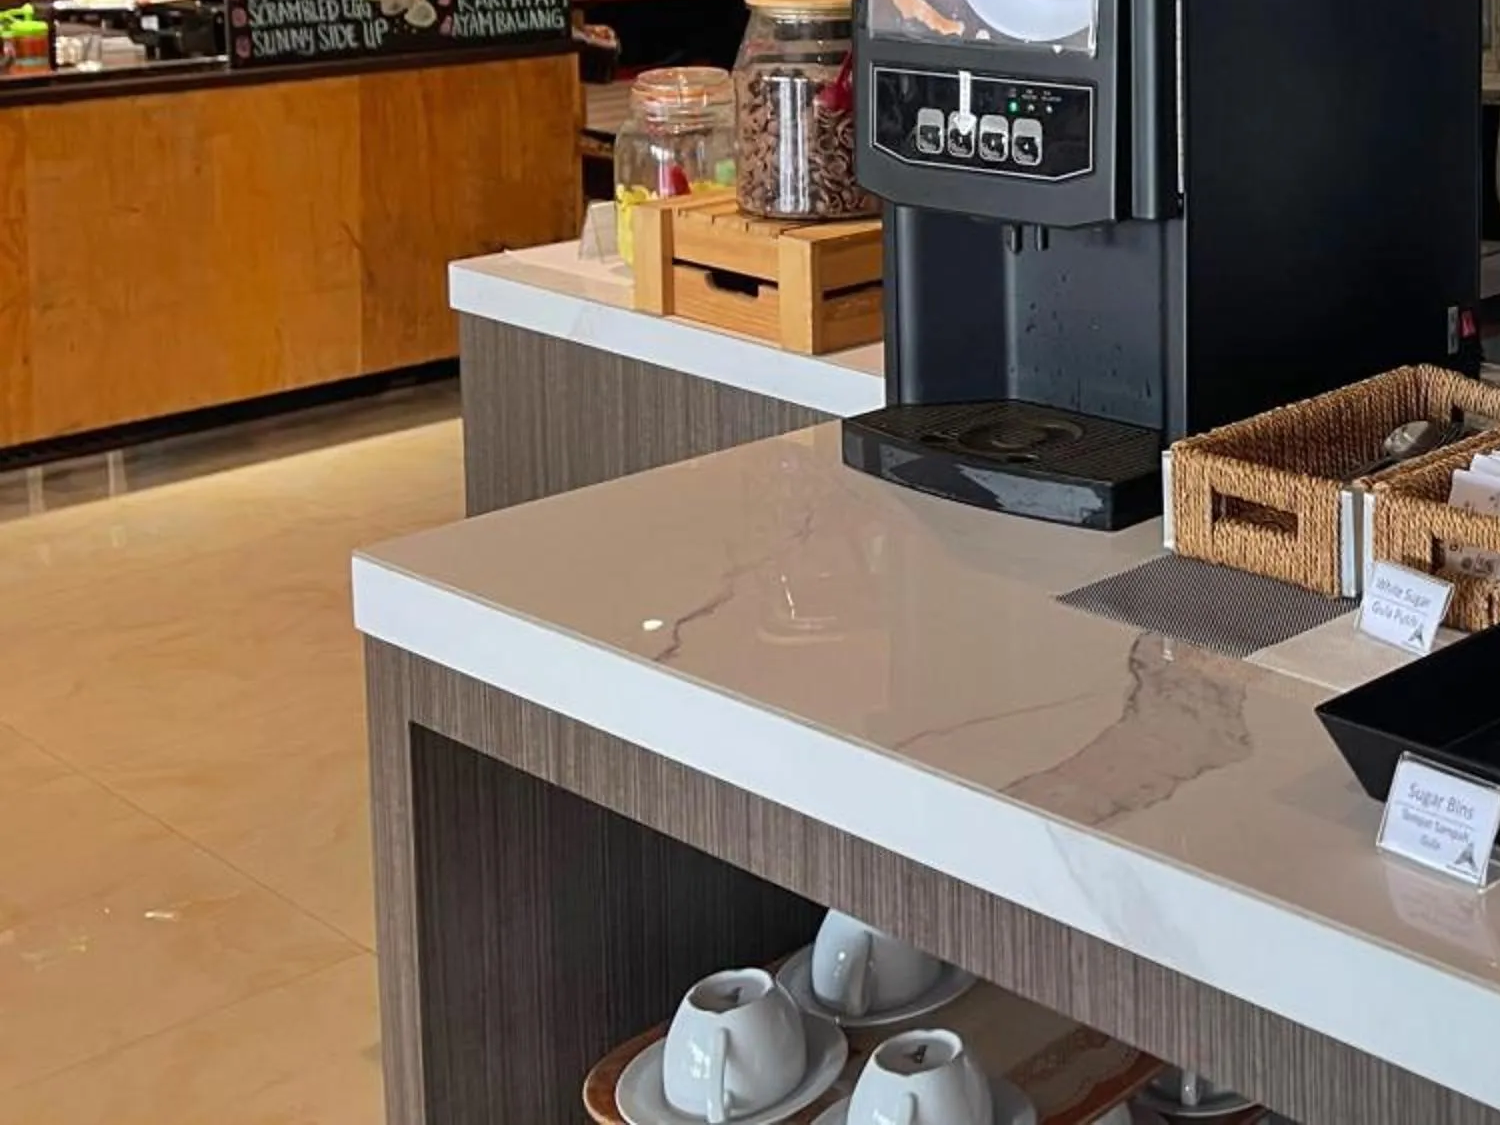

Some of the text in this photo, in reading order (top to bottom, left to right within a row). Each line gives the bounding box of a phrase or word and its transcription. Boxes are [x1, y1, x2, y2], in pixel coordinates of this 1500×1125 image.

[317, 23, 359, 51] SIDE
[363, 17, 389, 49] UP
[452, 7, 565, 37] AYAM BAWANG
[1408, 781, 1474, 821] Sugar Bins
